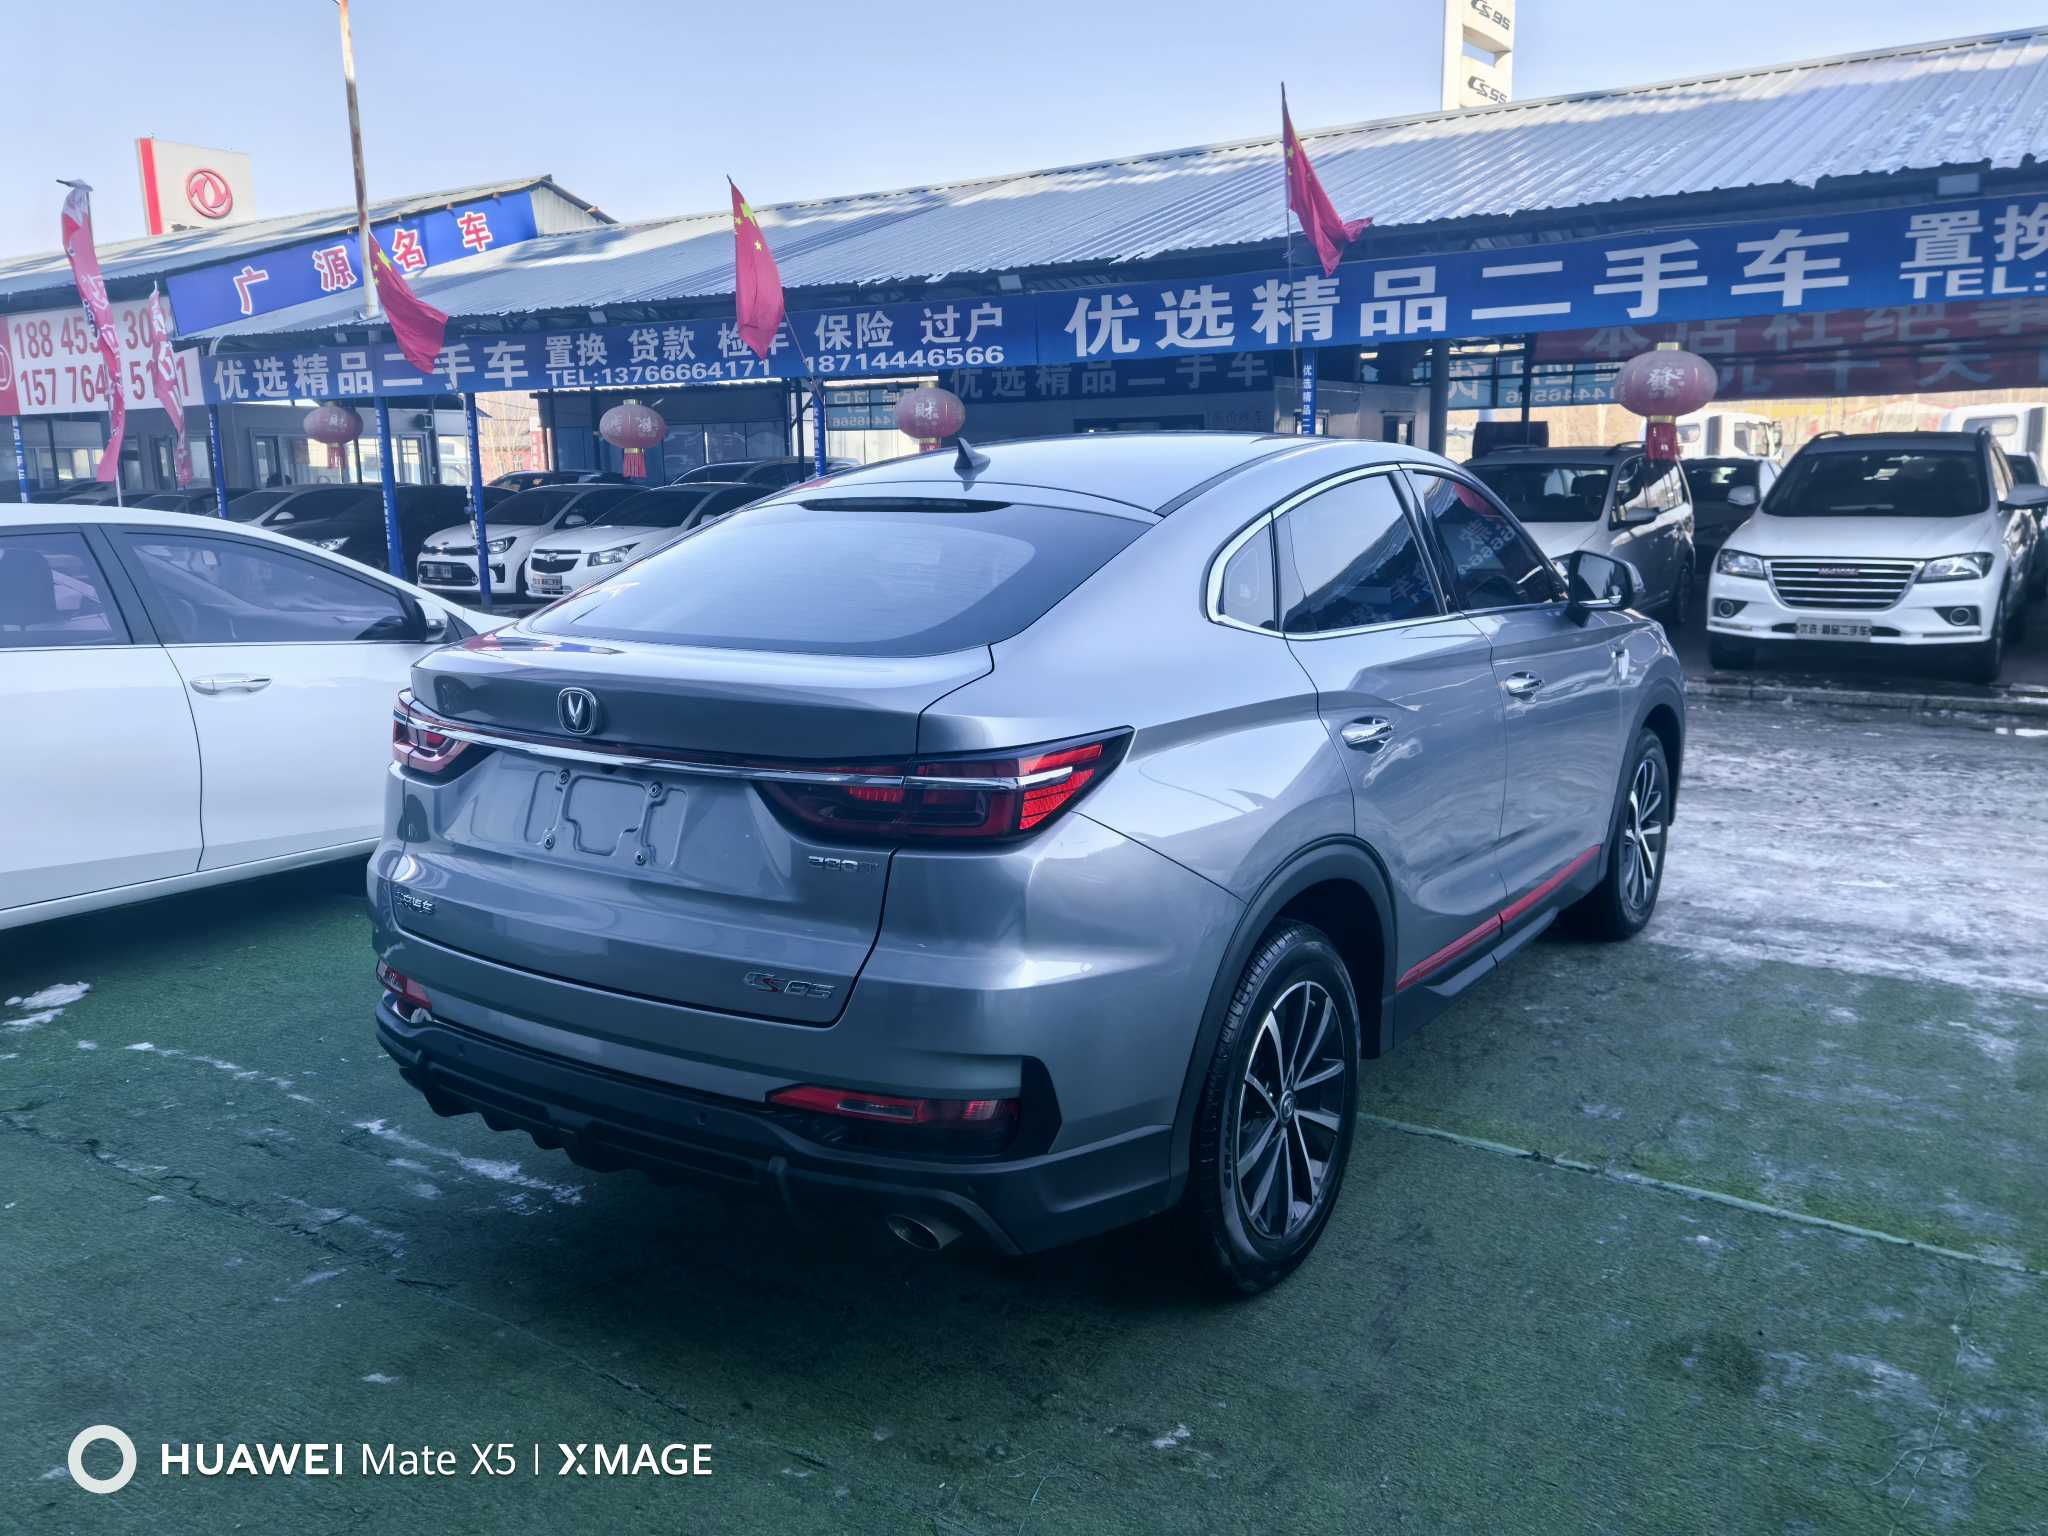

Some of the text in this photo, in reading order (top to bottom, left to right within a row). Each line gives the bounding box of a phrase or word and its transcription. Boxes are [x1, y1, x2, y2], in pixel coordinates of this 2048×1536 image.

[232, 211, 493, 316] 广源名车
[1064, 228, 1850, 357] 优选精品二手车
[14, 320, 53, 359] 188
[545, 333, 608, 368] 置换
[627, 325, 697, 363] 贷款
[814, 310, 894, 351] 保险
[920, 302, 1004, 344] 过户
[804, 345, 1005, 373] 18714446566
[20, 367, 57, 406] 157
[213, 340, 529, 400] 优选精品二手车
